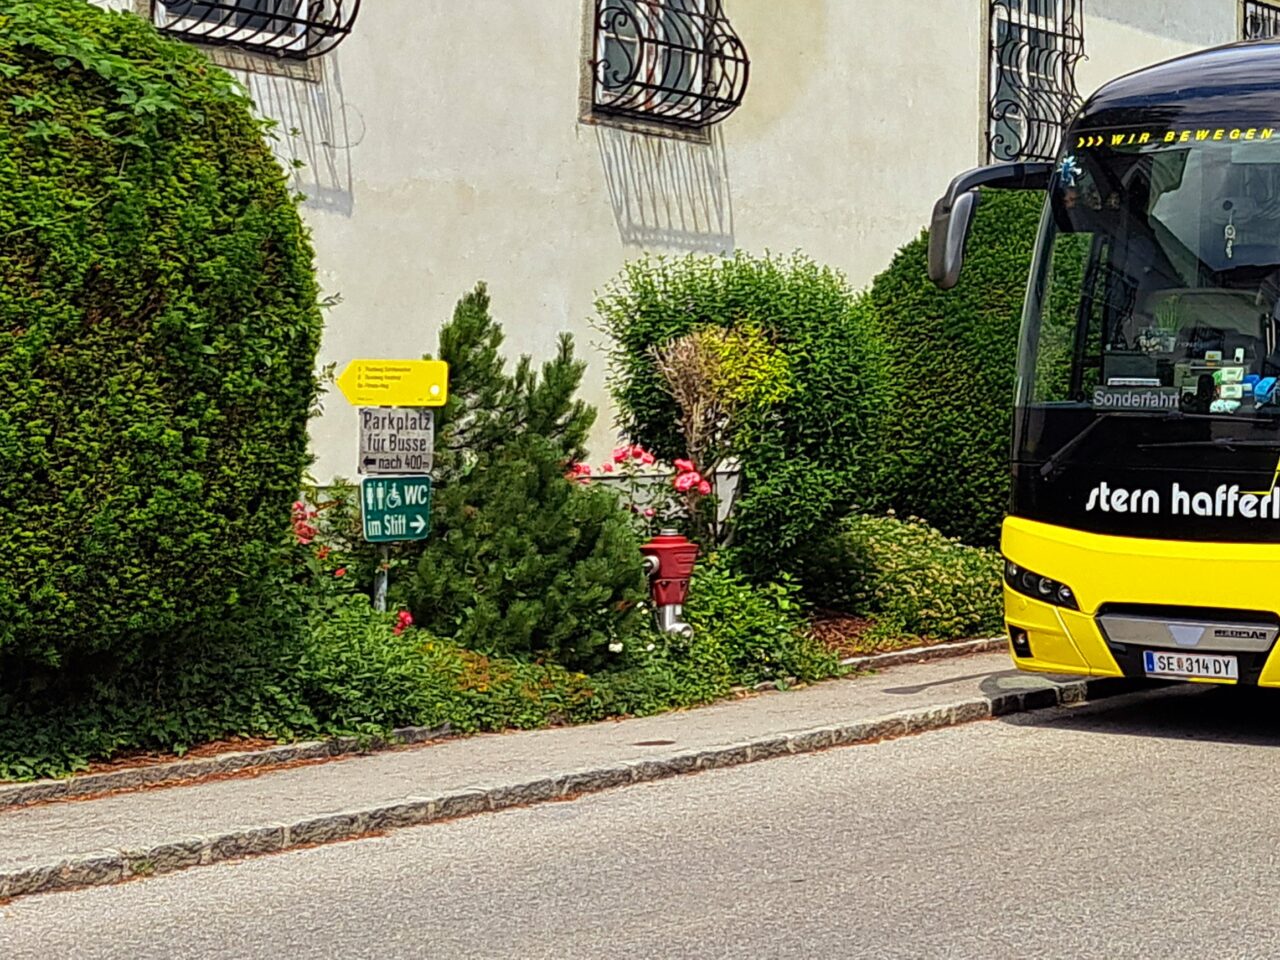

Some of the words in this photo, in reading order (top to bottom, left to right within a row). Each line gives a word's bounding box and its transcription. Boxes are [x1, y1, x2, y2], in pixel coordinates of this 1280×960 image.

[1110, 132, 1151, 146] WIR
[1164, 127, 1274, 143] BEWEGEN
[1093, 389, 1180, 408] Sonderfahrt
[363, 412, 431, 436] Parkplatz
[367, 433, 387, 452] für
[389, 434, 427, 452] Busse
[378, 455, 402, 470] nach
[404, 484, 428, 505] WC
[1085, 480, 1160, 515] stern
[368, 515, 382, 536] im
[384, 514, 407, 536] Stift
[1157, 655, 1175, 671] SE
[1186, 657, 1209, 674] 314
[1213, 659, 1231, 675] DY
